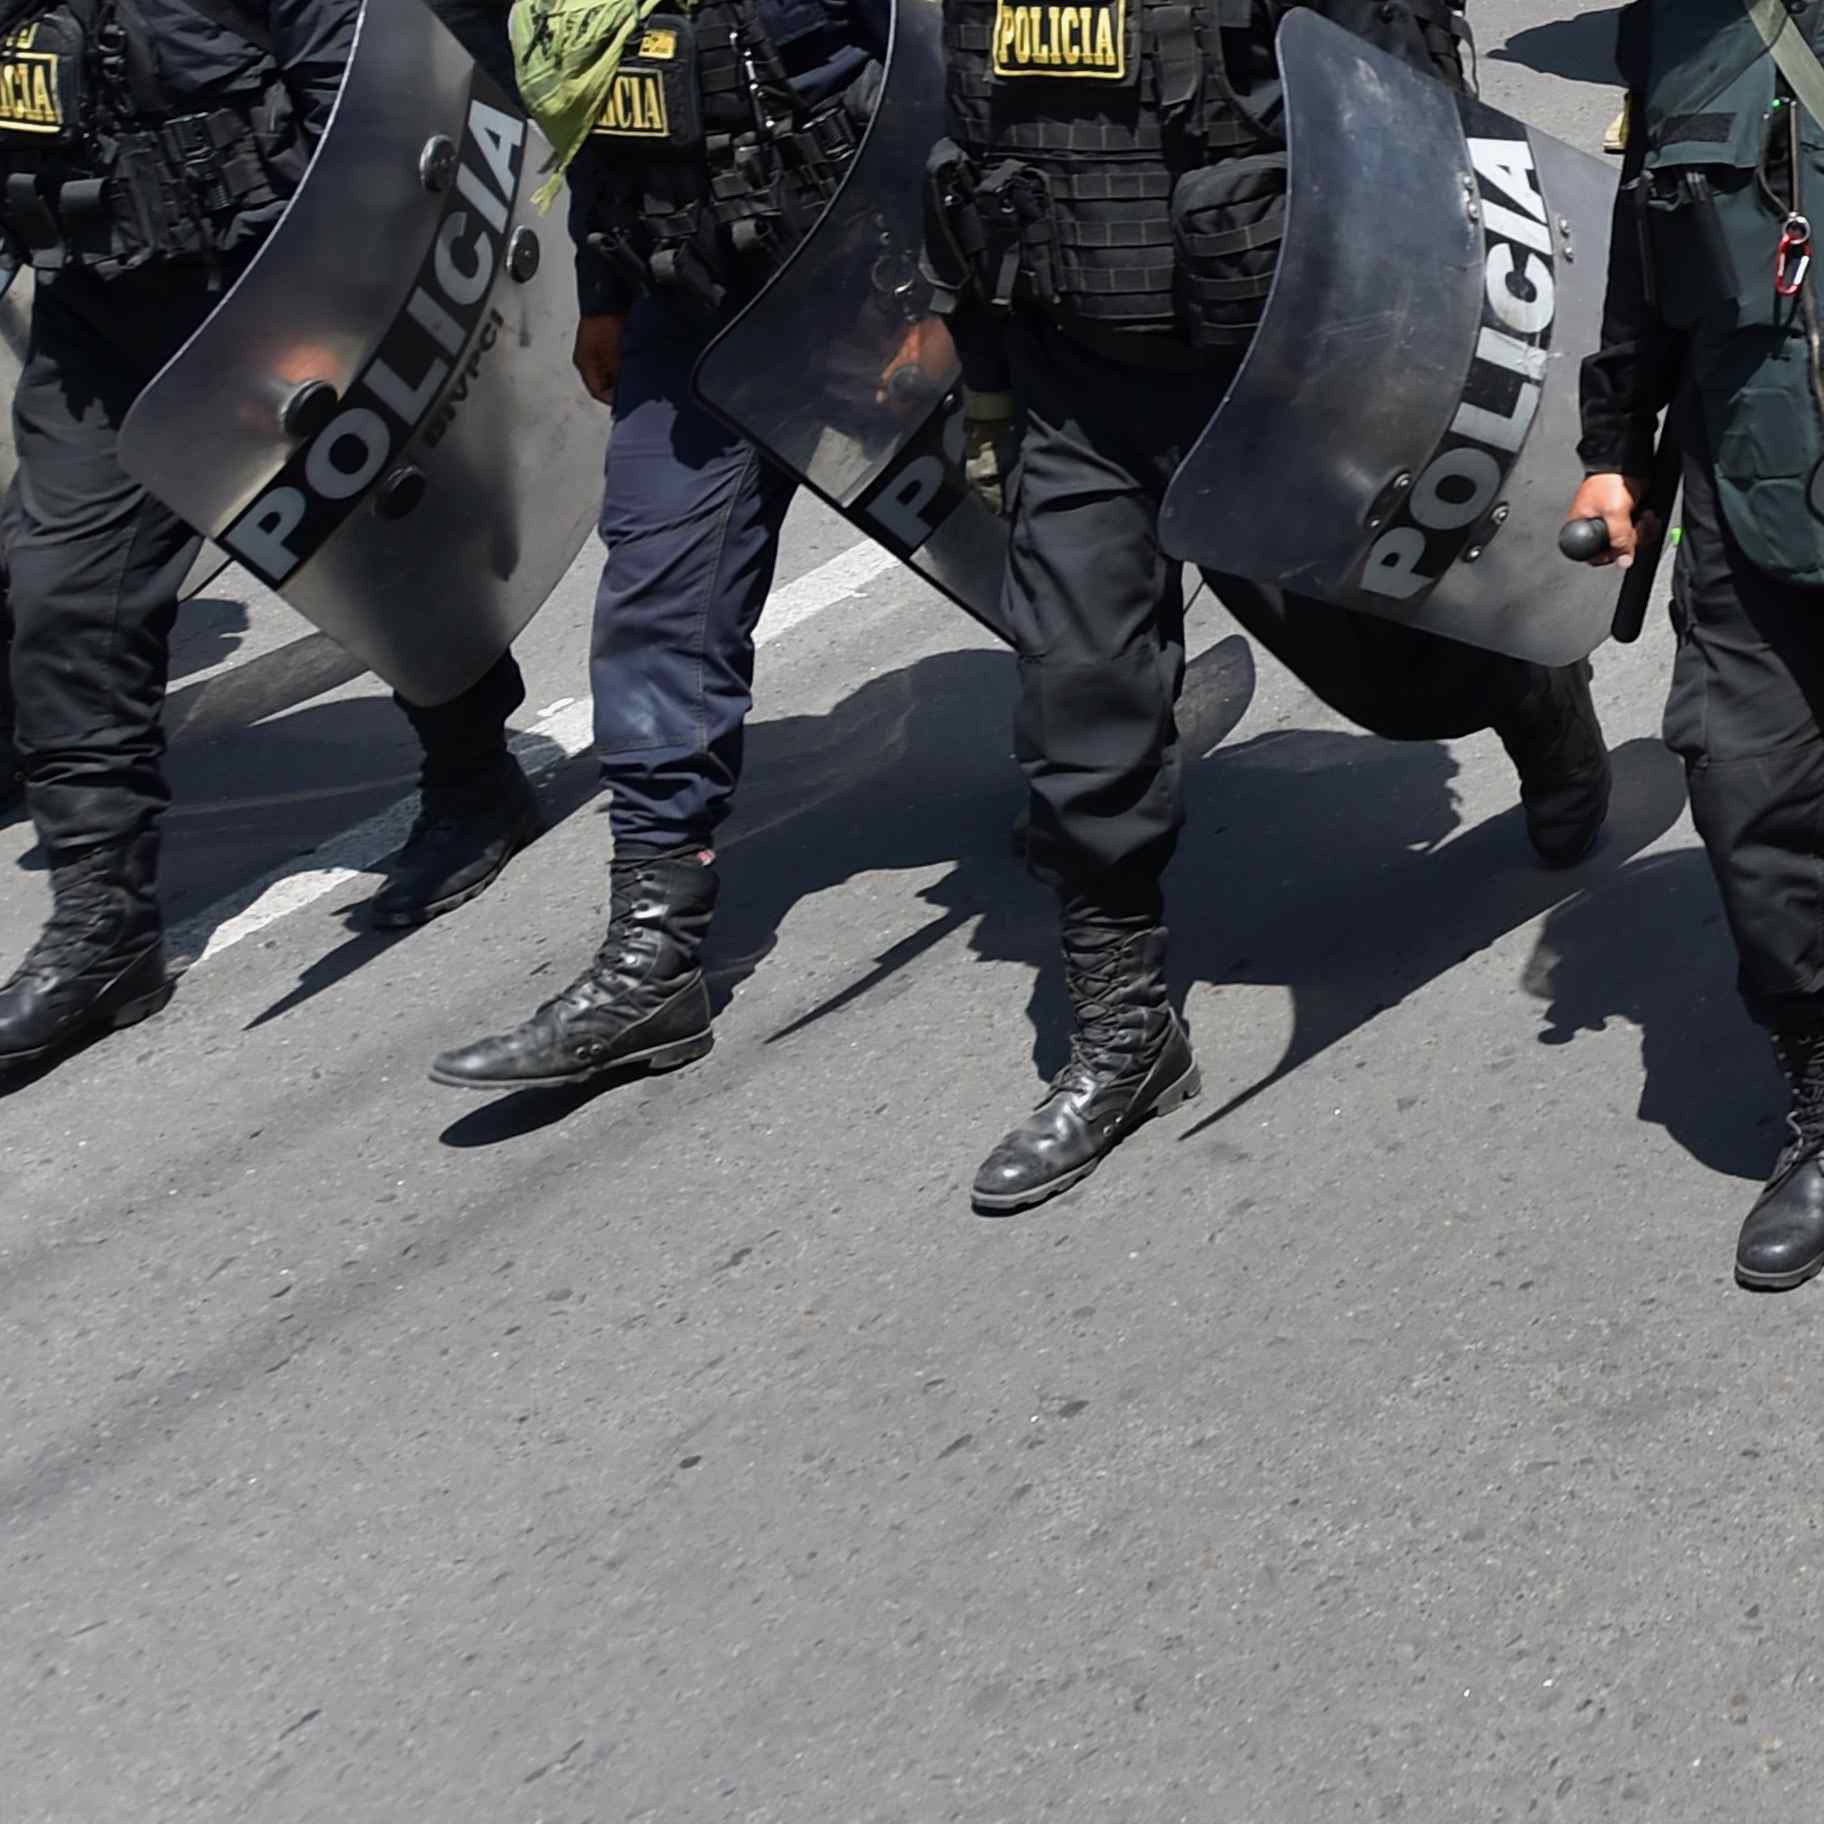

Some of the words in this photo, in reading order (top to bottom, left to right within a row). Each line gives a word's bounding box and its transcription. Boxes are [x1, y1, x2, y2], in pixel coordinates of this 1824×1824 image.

[999, 5, 1117, 66] POLICIA
[231, 98, 526, 581] POLICIA
[1362, 135, 1559, 600] POLICIA
